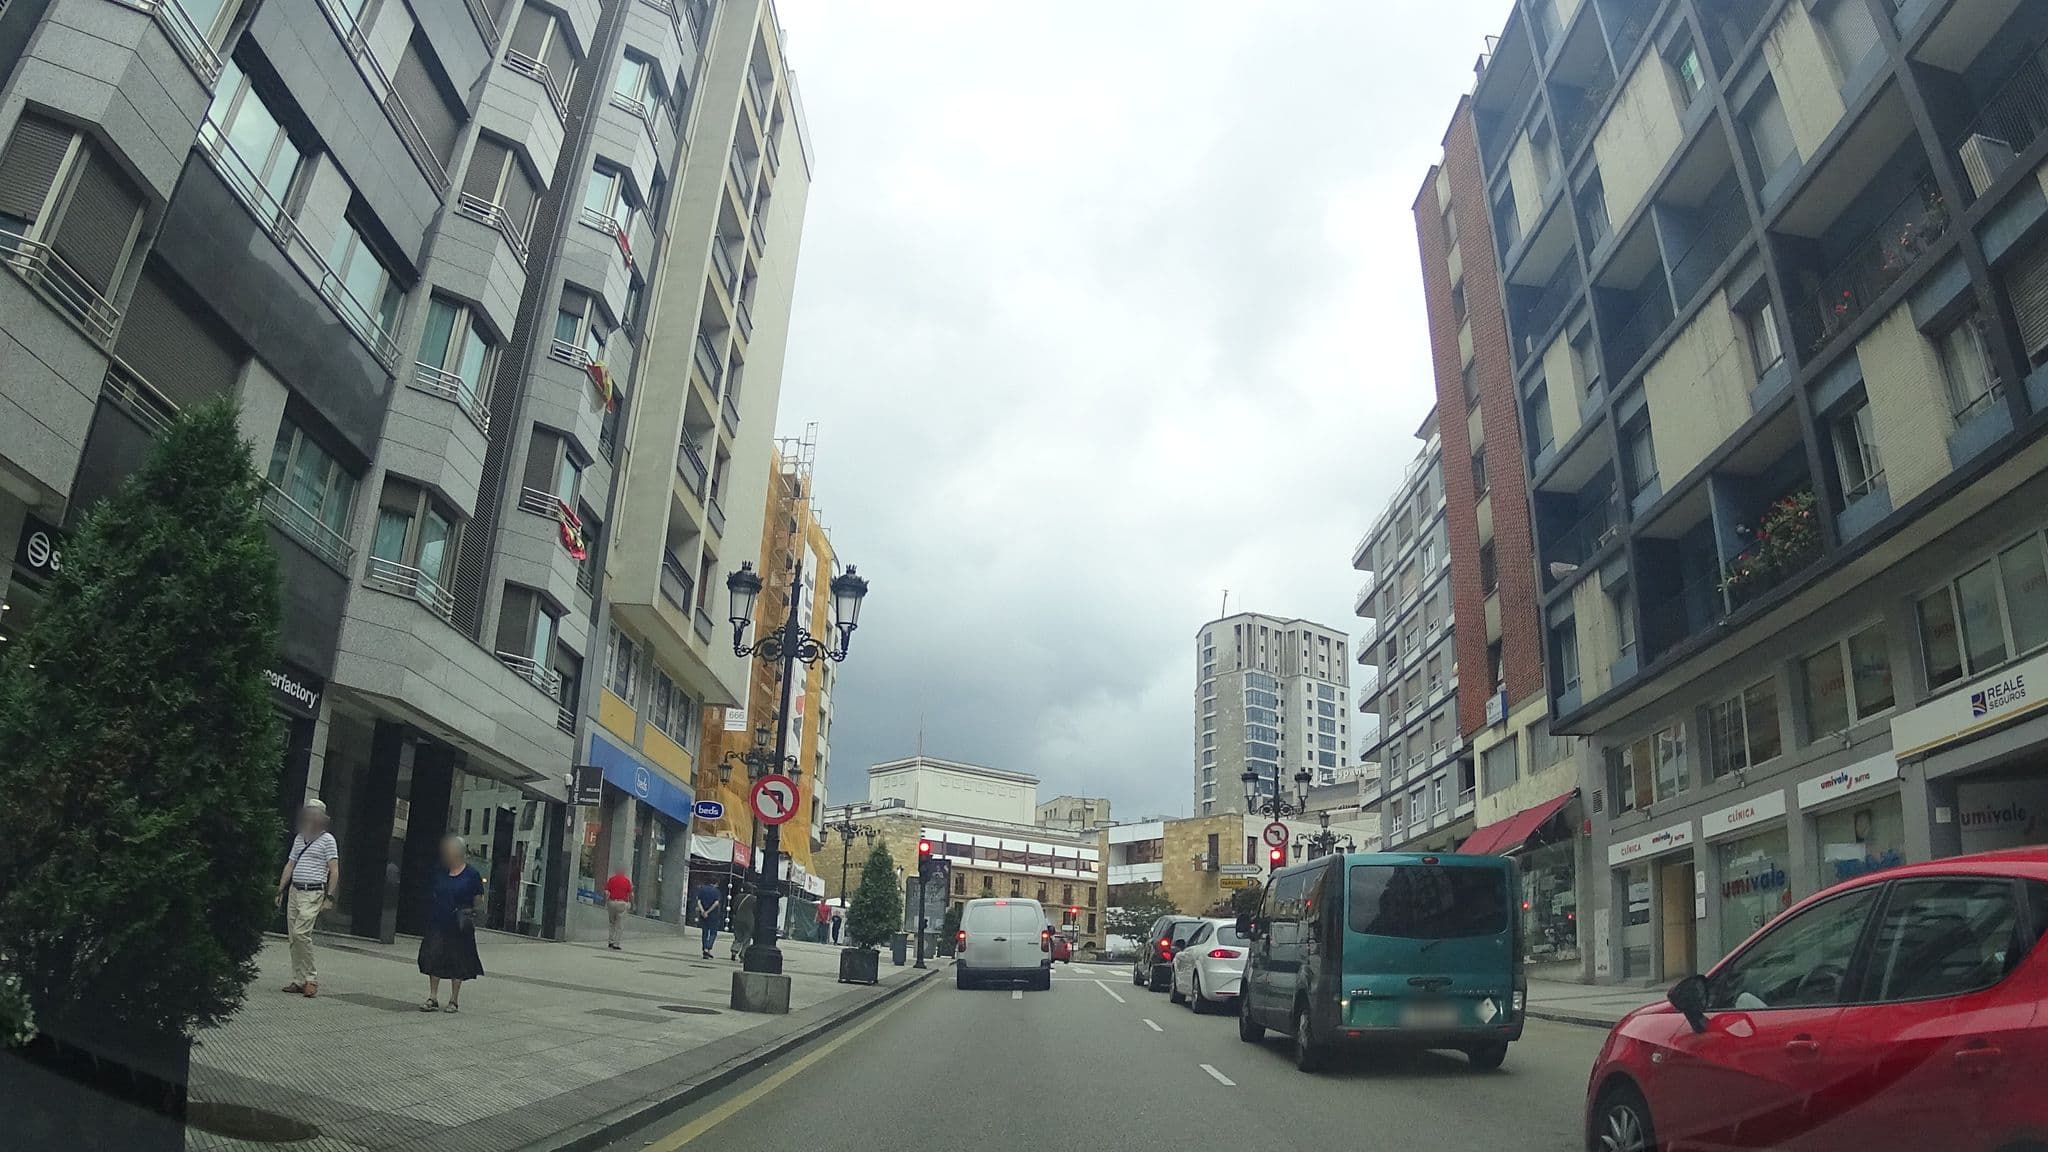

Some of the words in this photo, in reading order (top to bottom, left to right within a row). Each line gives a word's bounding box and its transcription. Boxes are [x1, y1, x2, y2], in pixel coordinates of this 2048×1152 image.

[1987, 675, 2025, 701] REALE
[1989, 689, 2026, 710] SEGUROS
[1820, 772, 1848, 790] umivale
[1727, 807, 1755, 823] CLÍNICA
[1960, 802, 2026, 826] umivale
[1721, 862, 1786, 898] umivale
